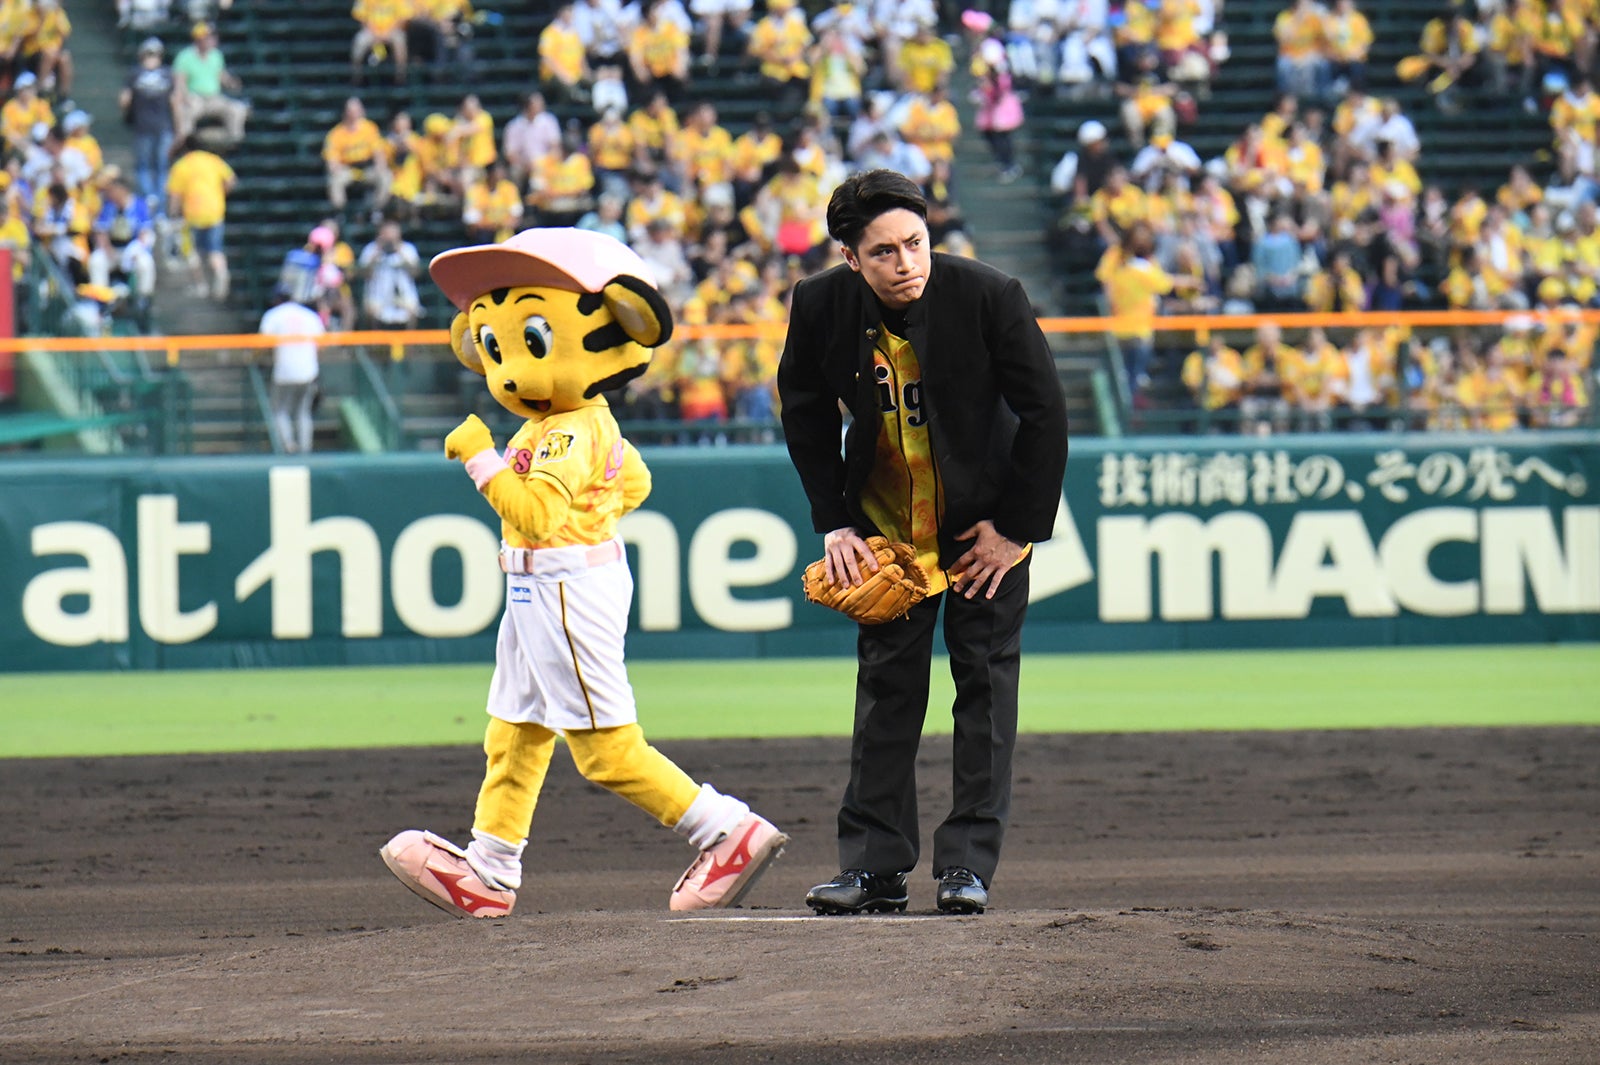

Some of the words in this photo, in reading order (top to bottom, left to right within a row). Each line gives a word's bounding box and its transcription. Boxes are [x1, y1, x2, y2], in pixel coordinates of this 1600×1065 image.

[1098, 449, 1587, 506] 技術商社の、その先へ。
[22, 494, 218, 646] at
